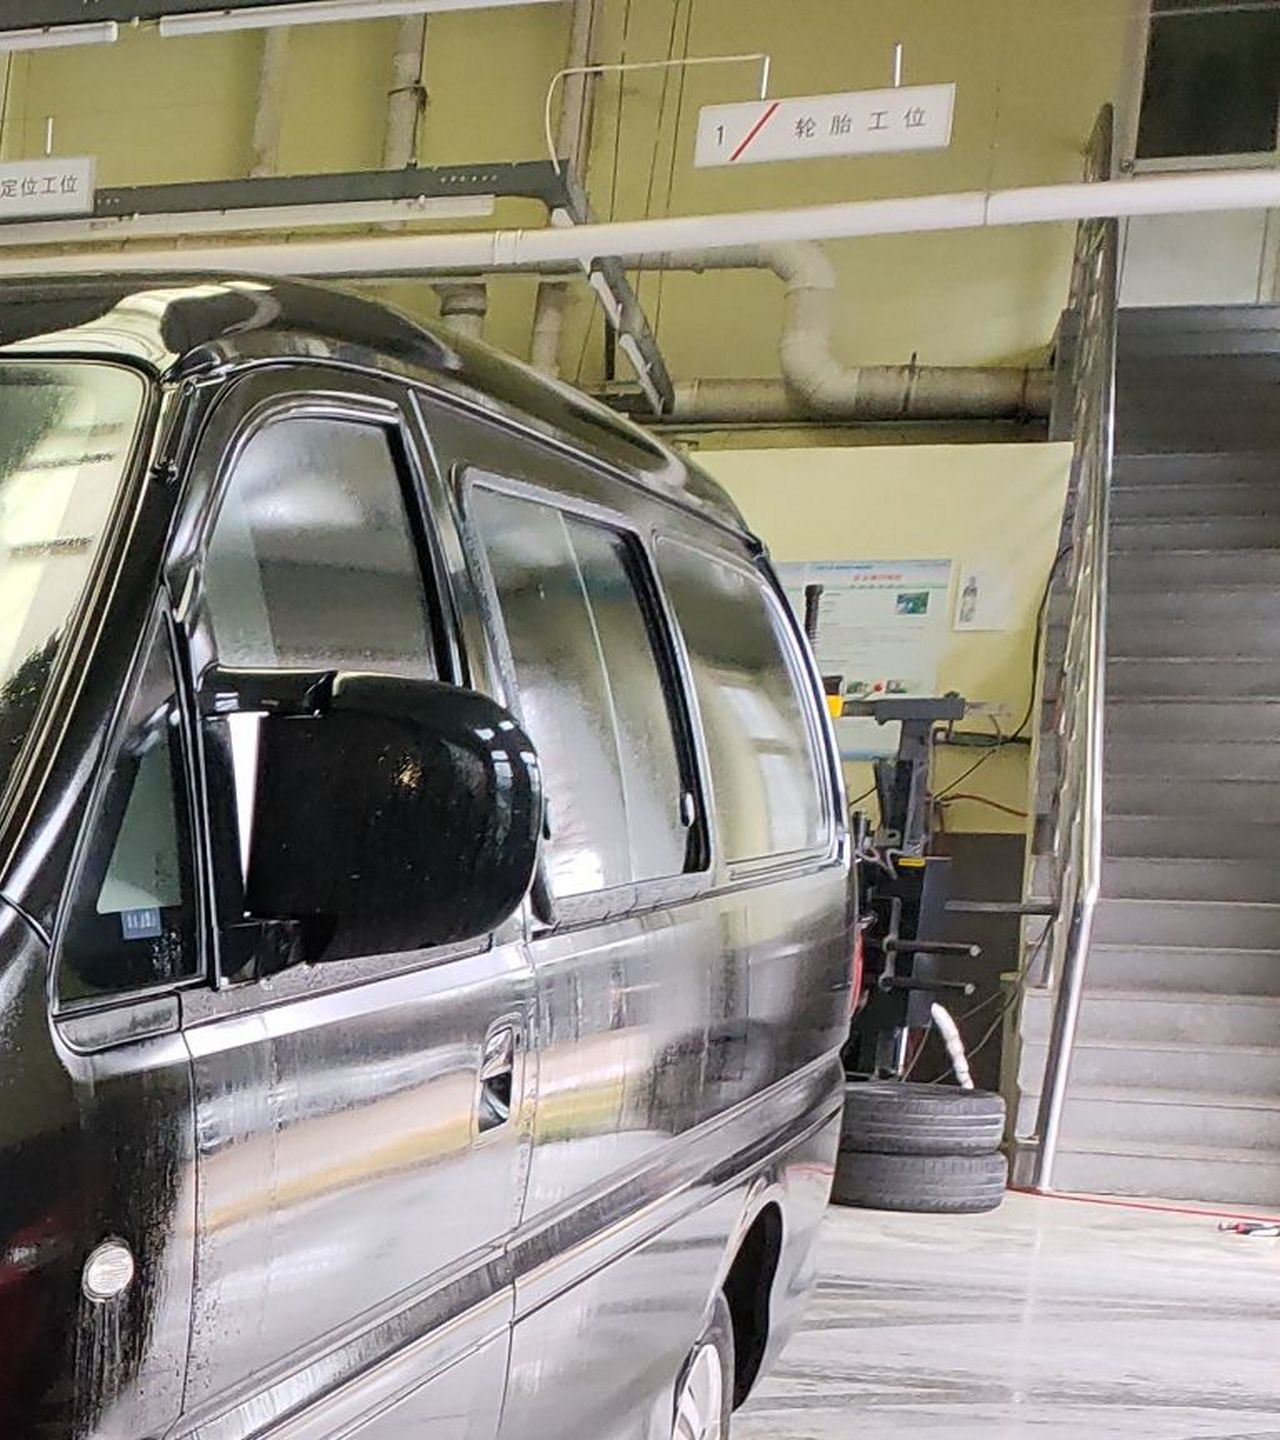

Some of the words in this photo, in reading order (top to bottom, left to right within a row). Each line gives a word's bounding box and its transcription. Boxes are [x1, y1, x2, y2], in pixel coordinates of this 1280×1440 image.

[715, 125, 725, 146] 1
[794, 107, 927, 140] 轮胎工位
